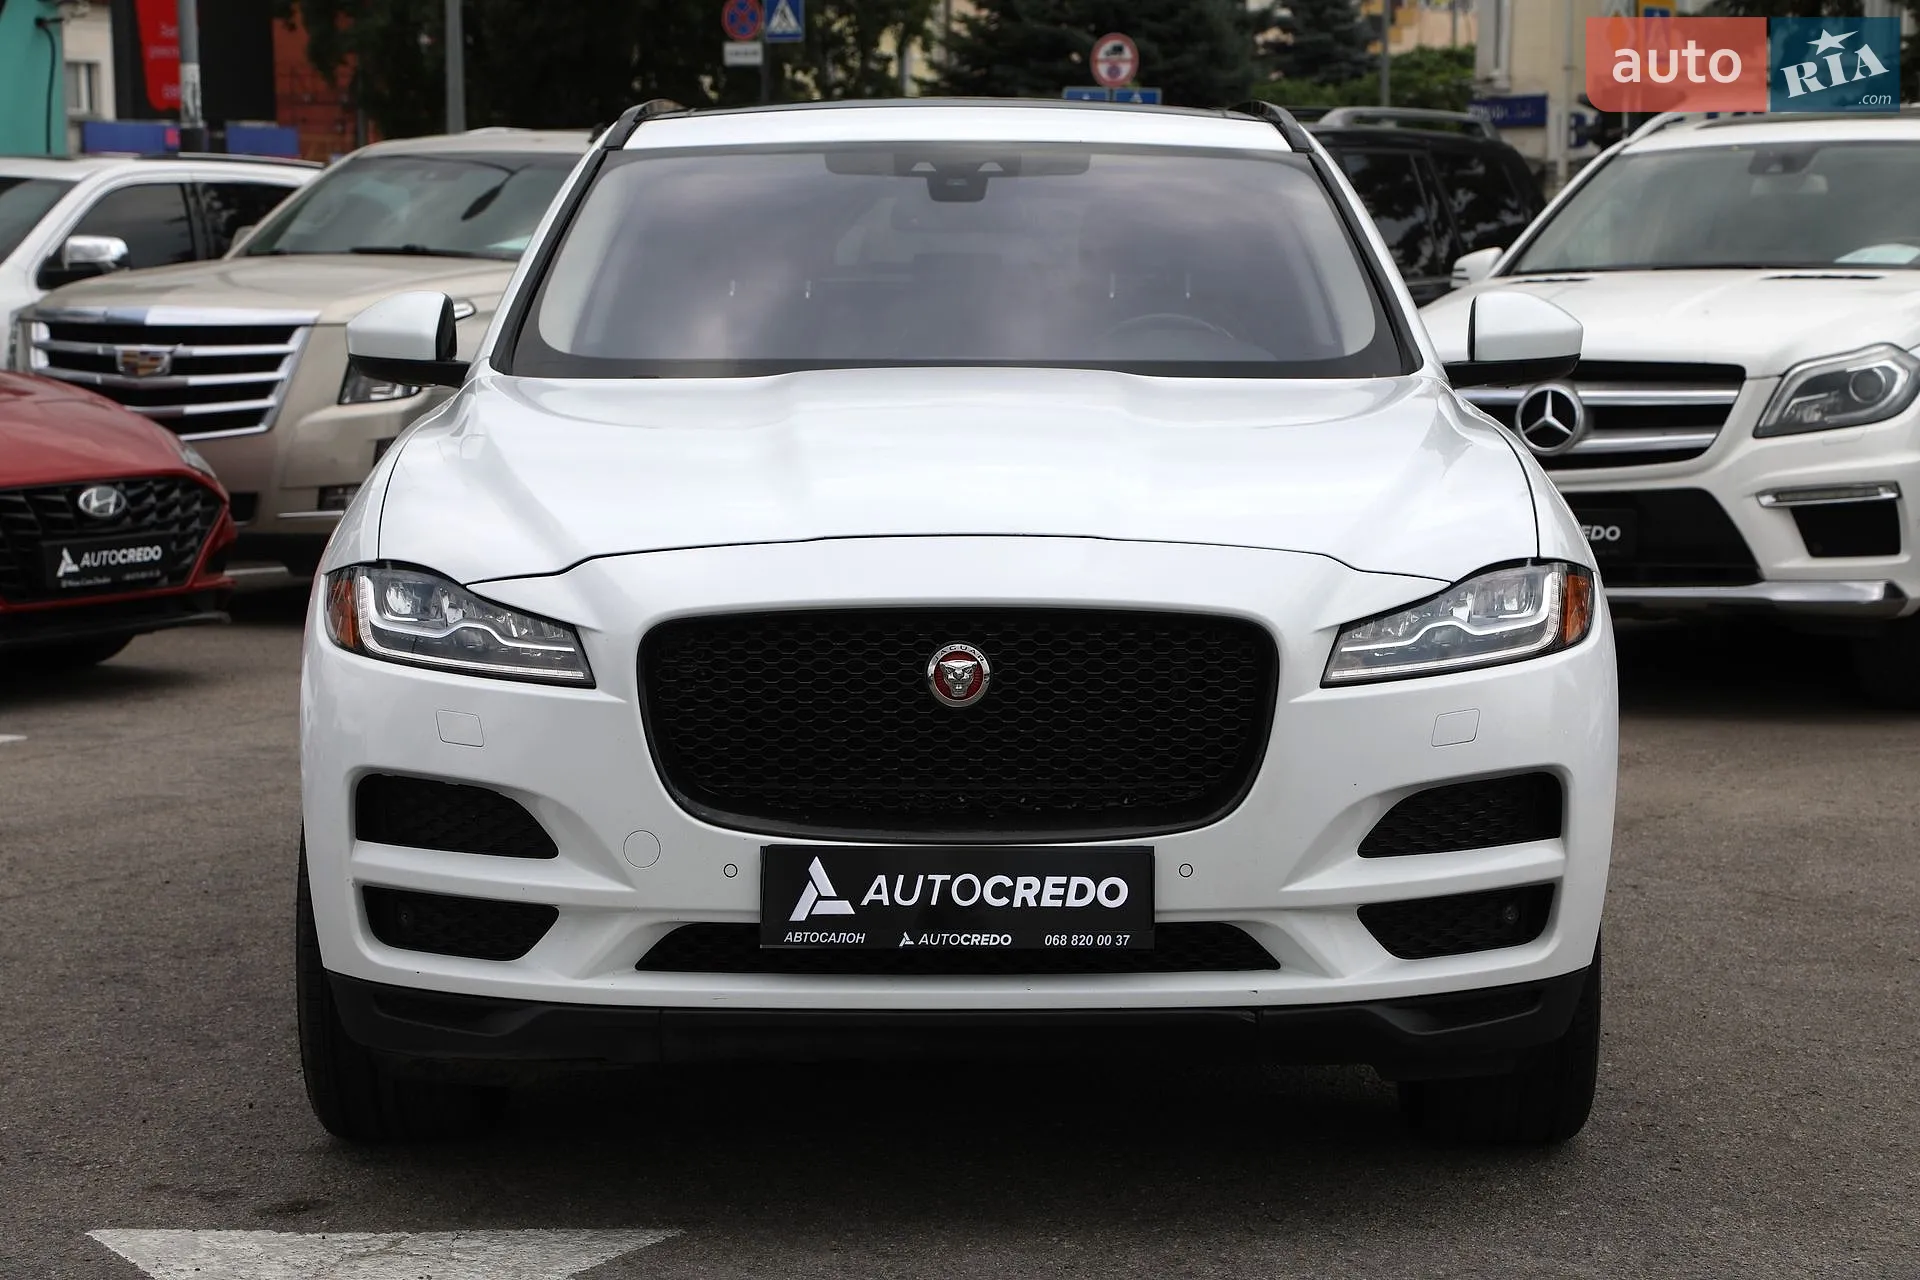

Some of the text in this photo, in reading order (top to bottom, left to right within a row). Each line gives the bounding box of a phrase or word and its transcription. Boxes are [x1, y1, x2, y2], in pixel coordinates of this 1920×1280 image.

[80, 545, 162, 568] AUTOCREDO
[932, 645, 984, 663] JAGUAR
[860, 873, 1129, 908] AUTOCREDO
[783, 932, 866, 944] АВТОСАЛОН
[918, 933, 1012, 946] AUTOCREDO
[1044, 934, 1131, 946] 068 820 00 37
